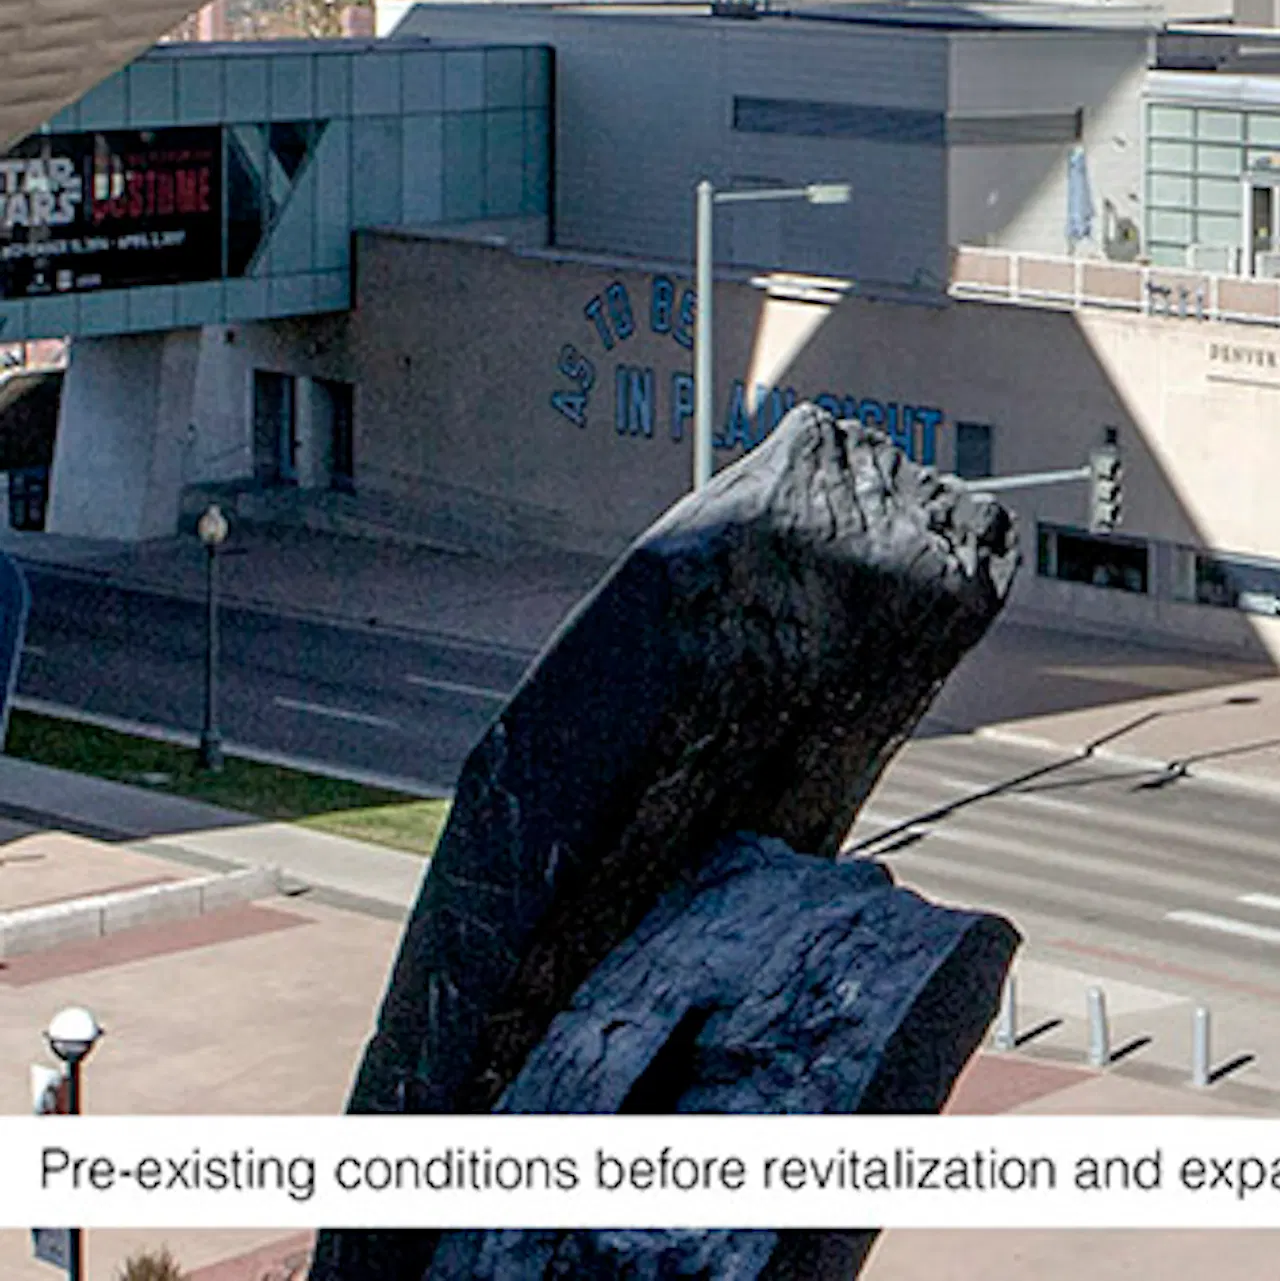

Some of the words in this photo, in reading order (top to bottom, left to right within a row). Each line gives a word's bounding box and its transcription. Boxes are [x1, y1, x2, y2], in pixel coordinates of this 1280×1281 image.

[0, 157, 82, 193] TAR
[0, 185, 82, 226] ARS
[551, 343, 596, 429] AS
[584, 280, 635, 351] TO
[651, 275, 695, 351] BE
[1207, 342, 1277, 369] DENVER
[615, 364, 654, 438] IN
[671, 372, 798, 451] PAIN
